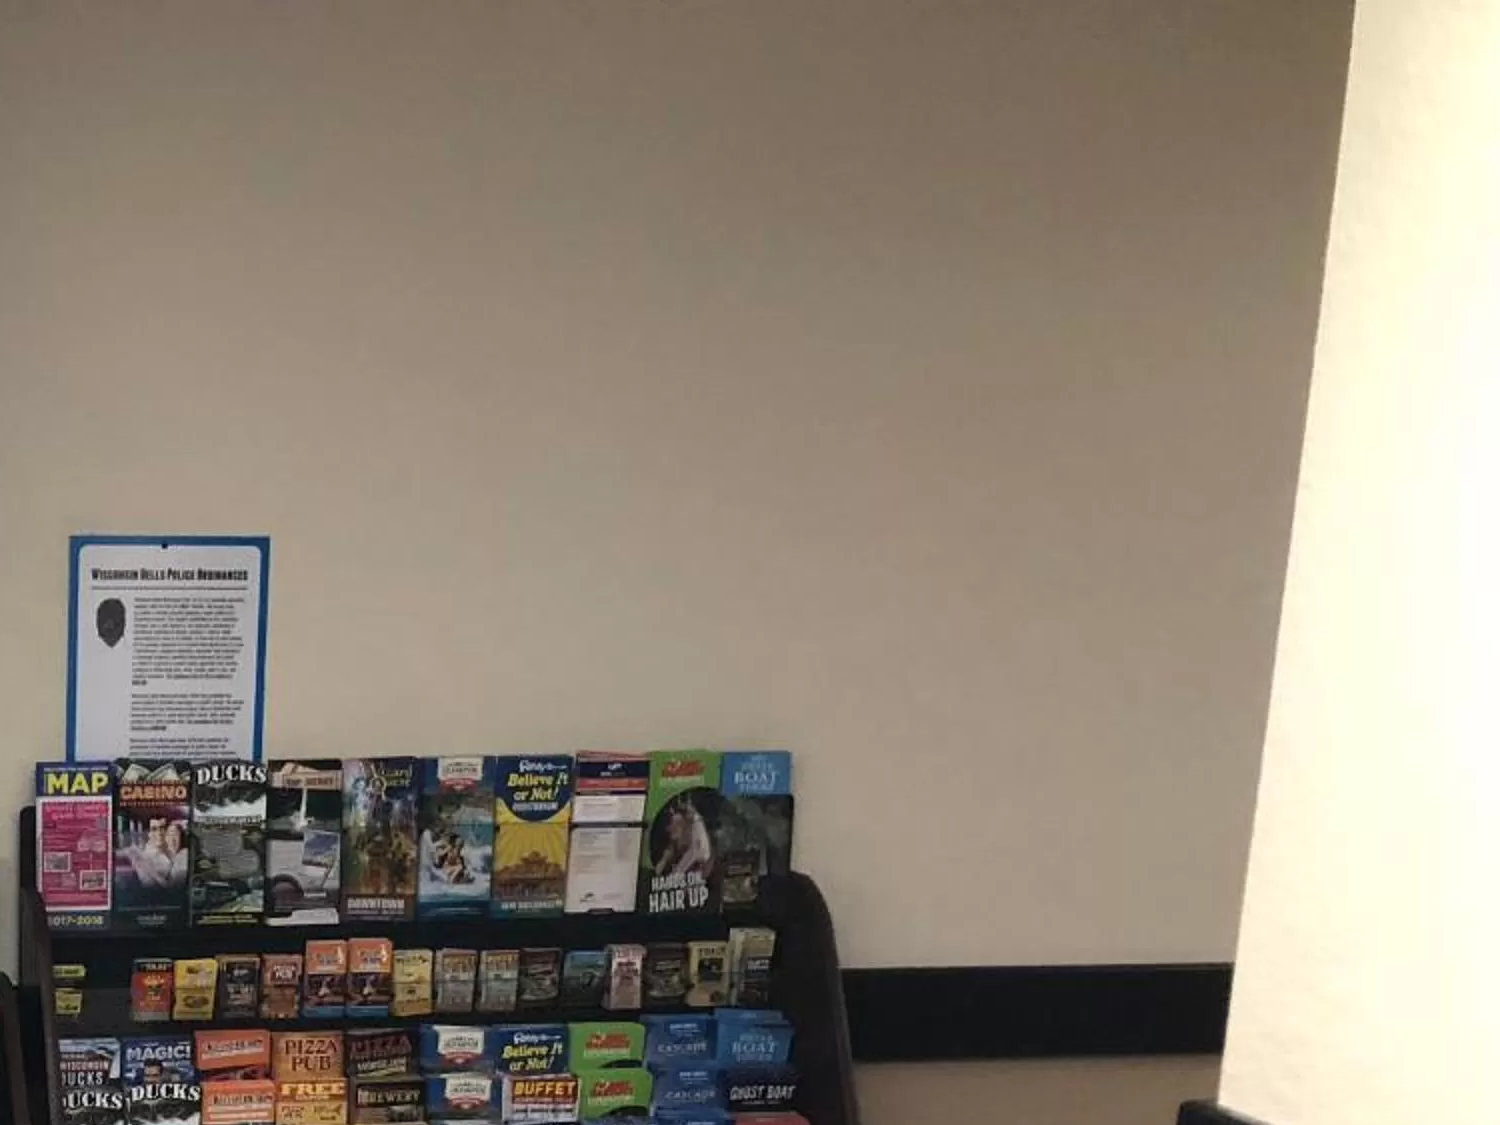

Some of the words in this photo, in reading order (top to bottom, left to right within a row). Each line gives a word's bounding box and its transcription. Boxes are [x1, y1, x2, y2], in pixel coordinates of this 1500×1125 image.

[197, 764, 267, 785] DUCKS
[507, 773, 553, 786] Believe
[47, 772, 109, 795] MAP
[120, 785, 187, 800] CASINO
[650, 892, 685, 913] HAIR
[688, 887, 708, 907] UP
[126, 1045, 191, 1061] MAGIC!
[285, 1039, 337, 1054] PIZZA
[503, 1043, 549, 1058] Believe
[292, 1056, 331, 1071] PUB
[131, 1083, 200, 1101] DUCKS
[281, 1083, 345, 1095] FREE
[514, 1081, 577, 1096] BUFFET
[63, 1090, 122, 1110] UCKS
